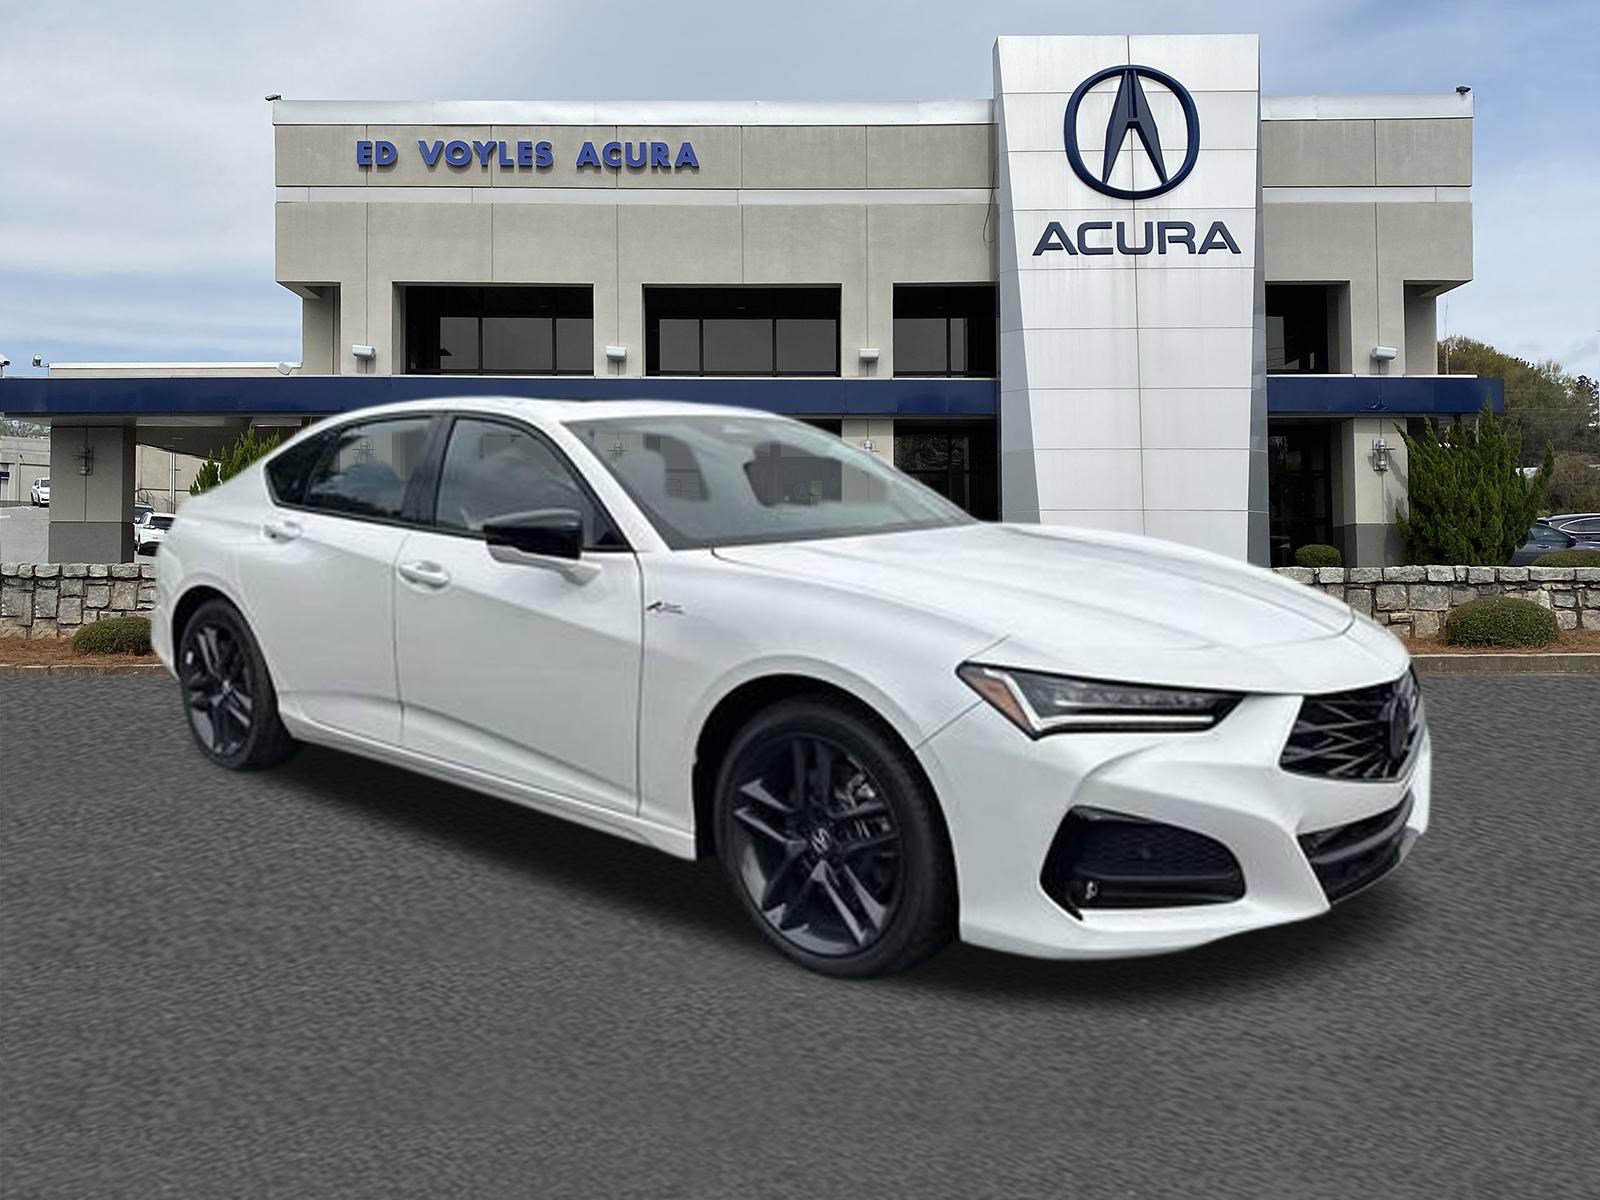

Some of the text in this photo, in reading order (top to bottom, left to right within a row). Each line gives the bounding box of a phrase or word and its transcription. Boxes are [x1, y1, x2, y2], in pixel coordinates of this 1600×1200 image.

[356, 140, 700, 169] ED VOYLES ACURA
[1032, 221, 1242, 256] ACURA
